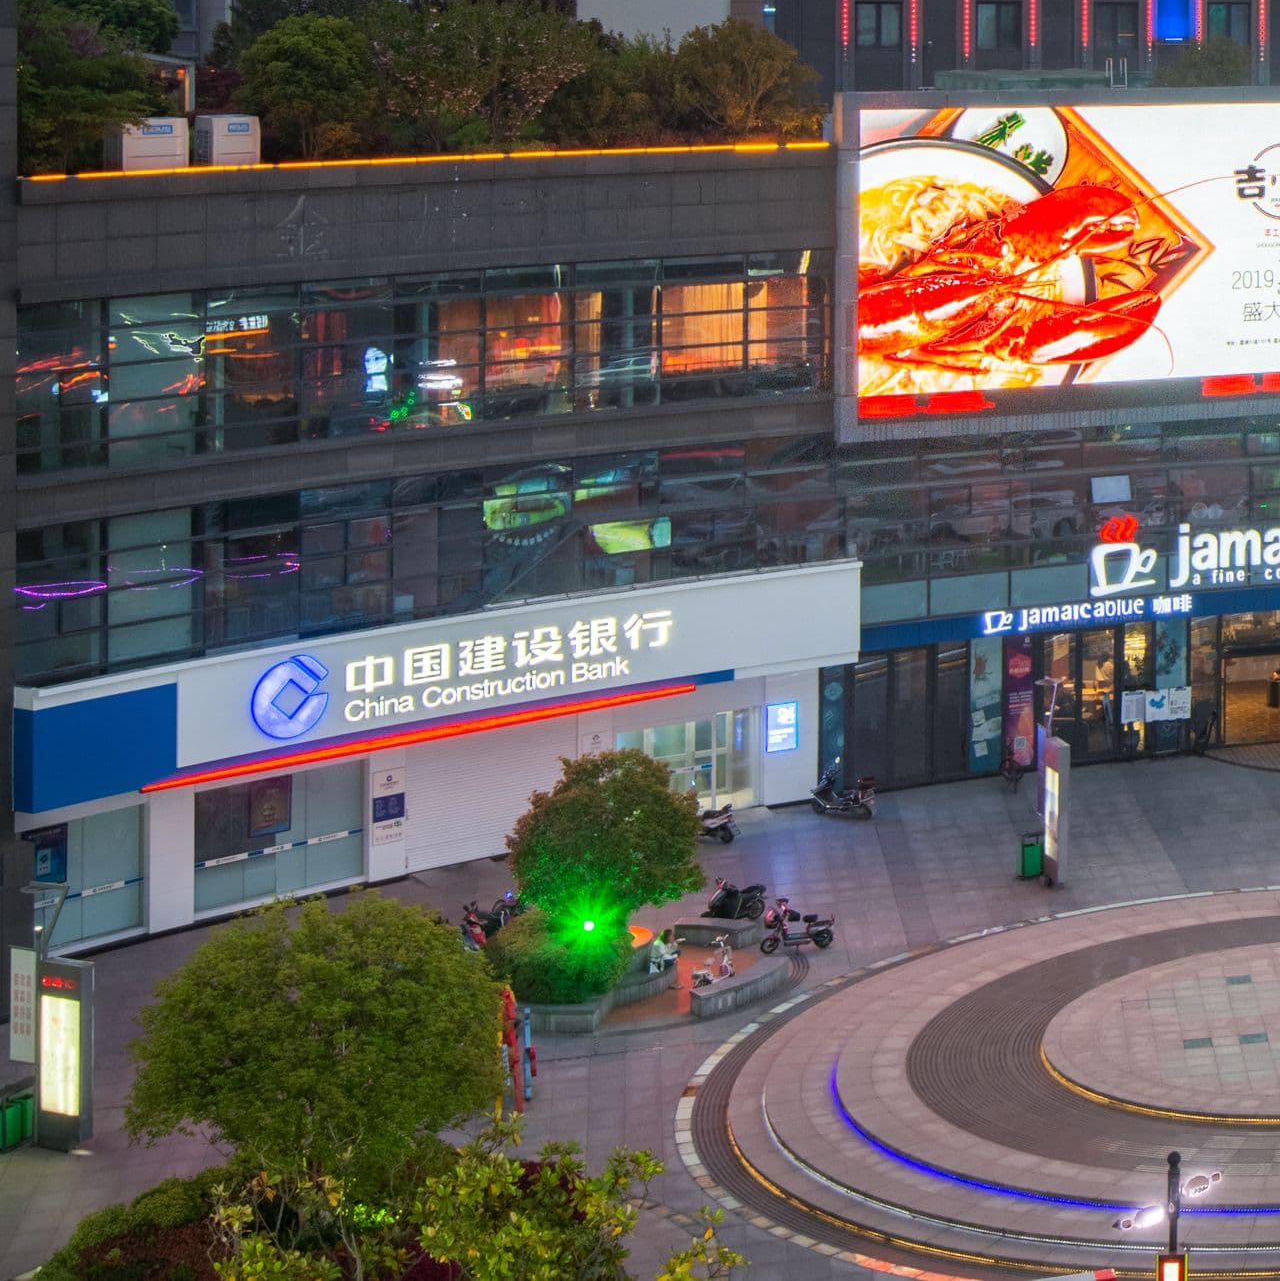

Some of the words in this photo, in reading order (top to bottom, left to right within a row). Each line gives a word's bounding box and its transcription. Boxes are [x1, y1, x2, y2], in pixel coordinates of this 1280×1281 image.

[1192, 573, 1201, 585] a
[1212, 568, 1246, 584] fine
[1152, 593, 1193, 615] 咖啡
[344, 609, 674, 694] 中国建设银行
[343, 695, 415, 723] China
[421, 669, 566, 709] Construction
[571, 656, 630, 685] Bank
